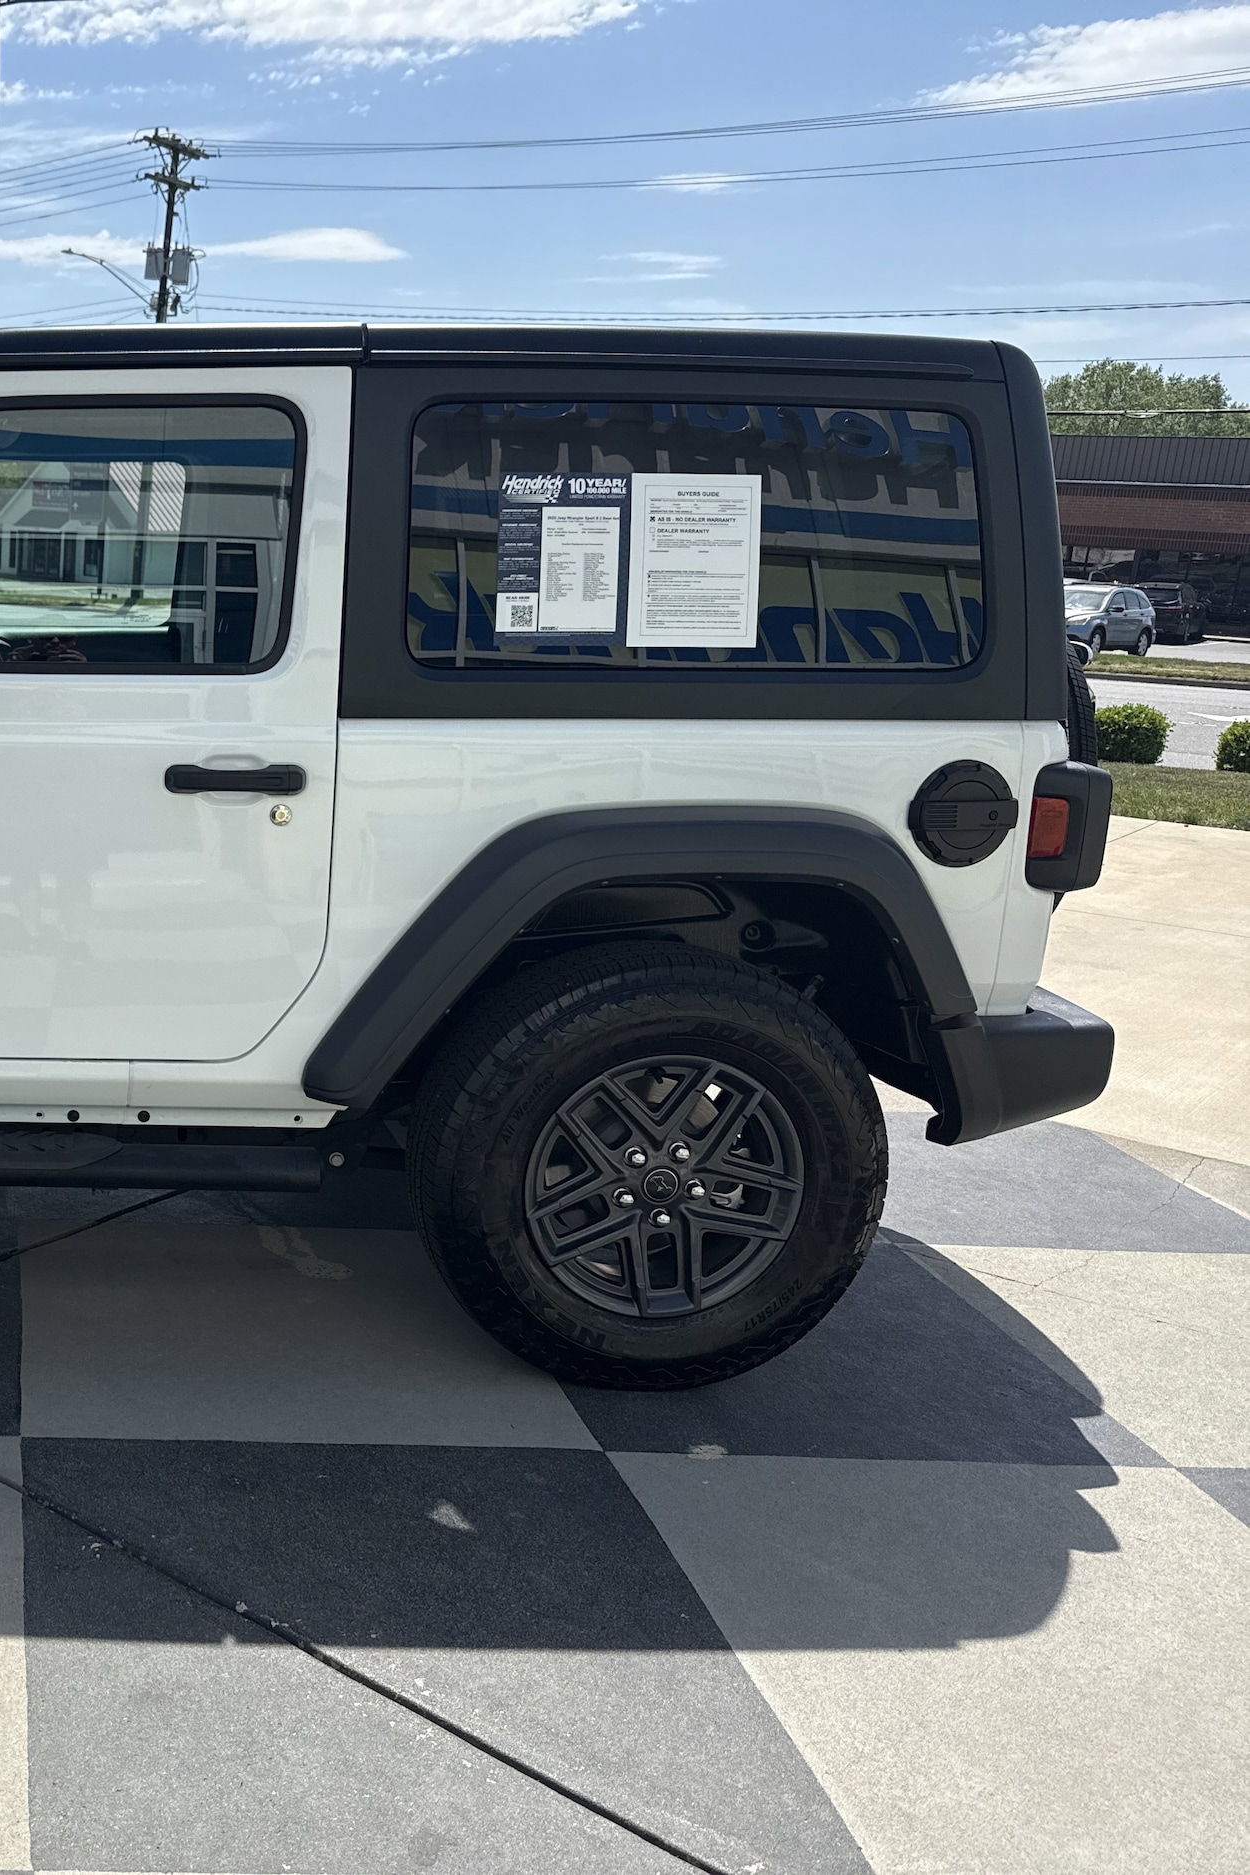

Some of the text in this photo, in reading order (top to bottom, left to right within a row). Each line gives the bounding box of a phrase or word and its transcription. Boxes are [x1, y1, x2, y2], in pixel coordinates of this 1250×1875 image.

[501, 475, 565, 494] Hendrick
[568, 478, 627, 494] 10 YEAR/
[501, 1069, 555, 1145] All-Weather
[496, 1238, 607, 1350] NEXEN
[743, 1277, 803, 1333] 245/75R17
